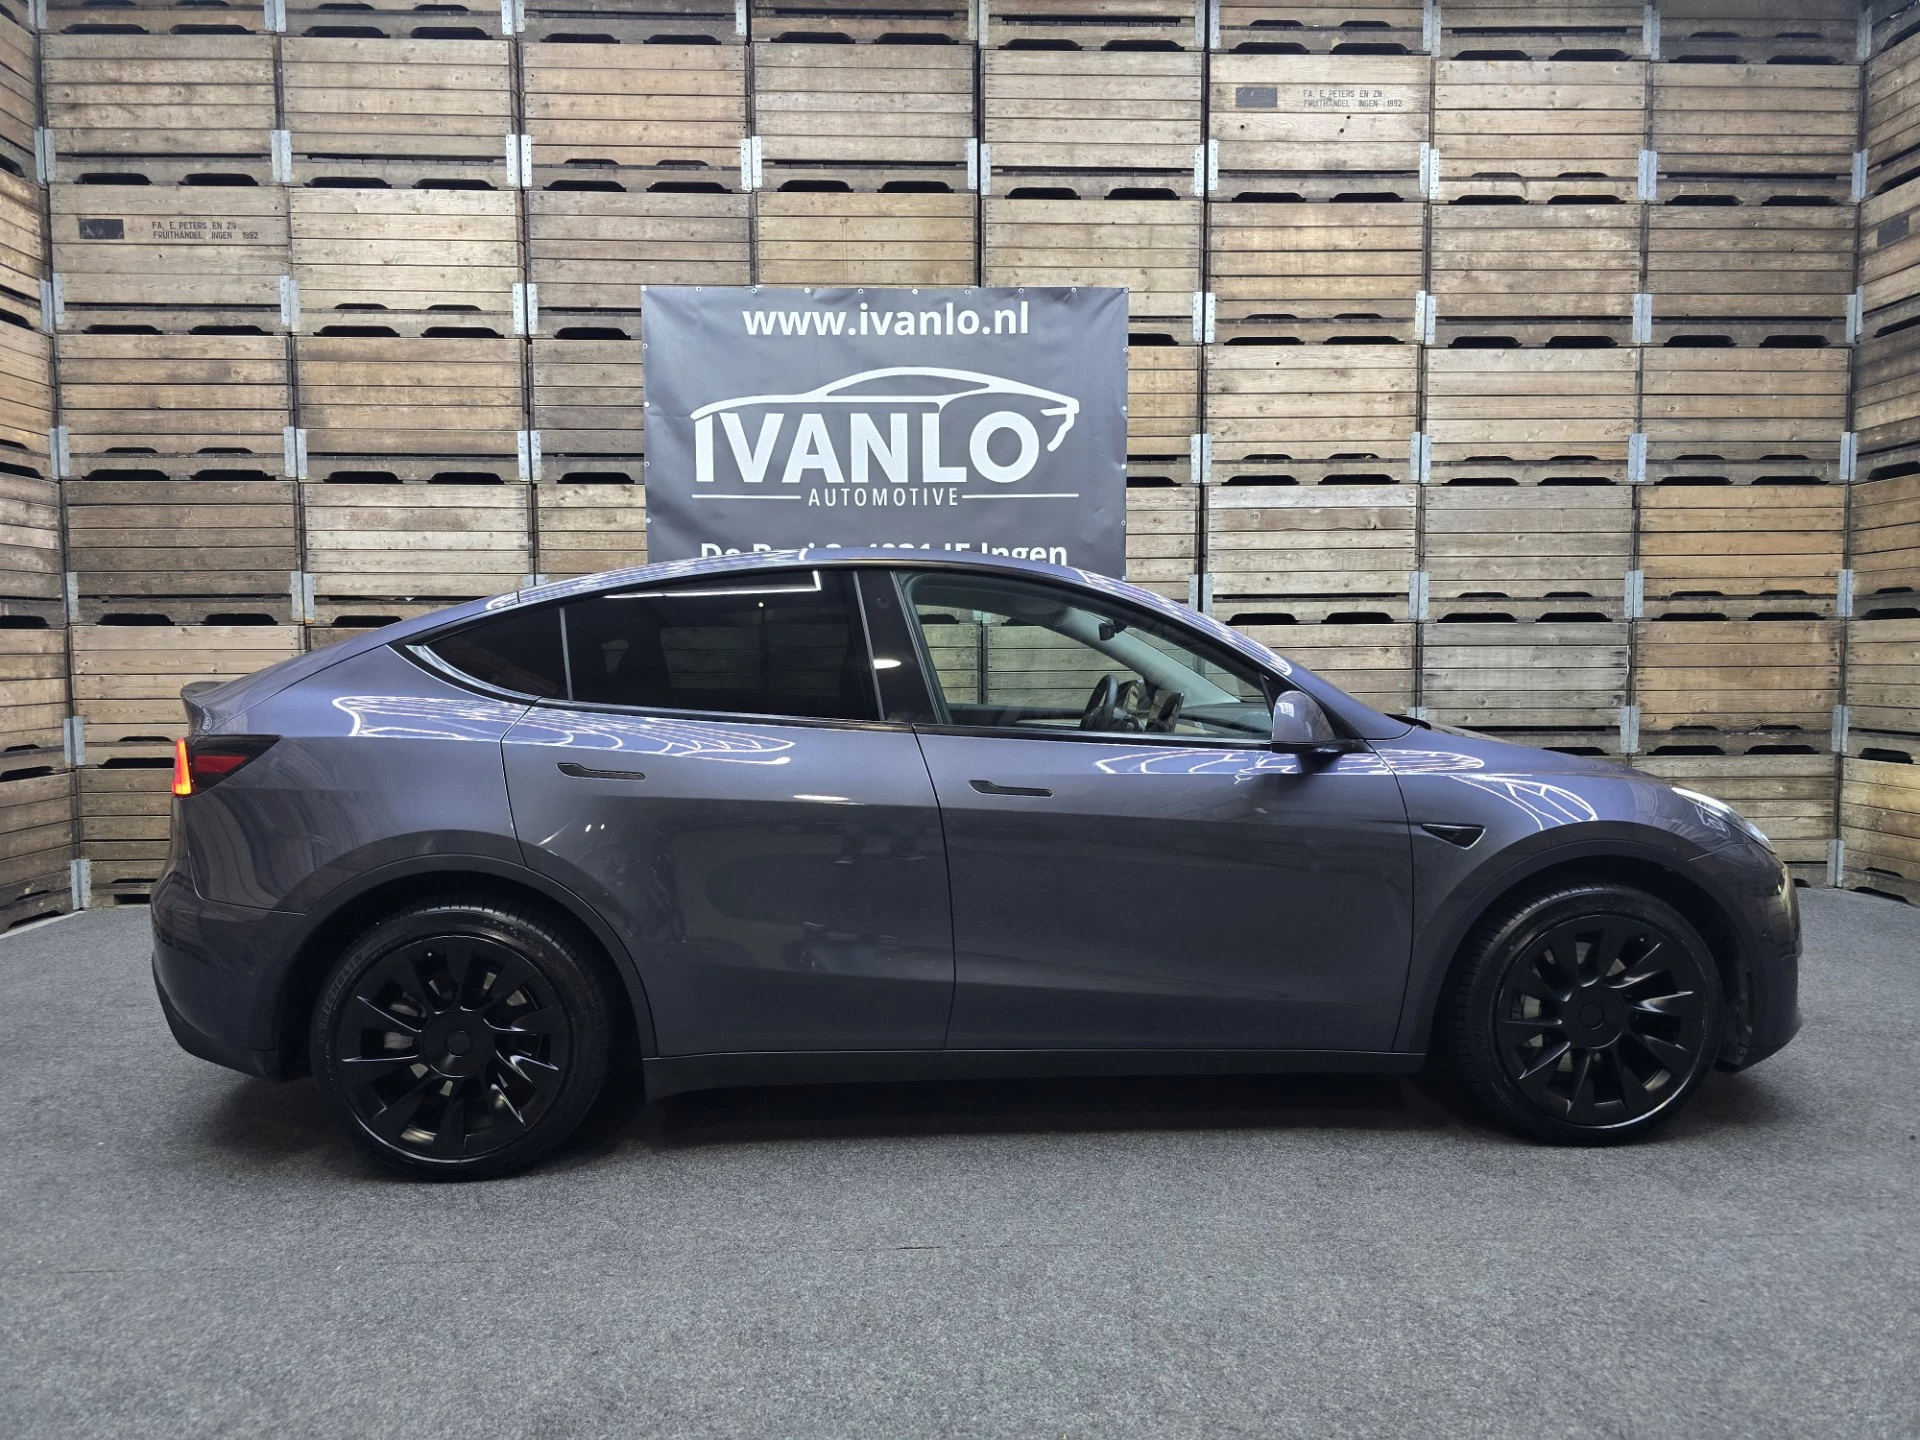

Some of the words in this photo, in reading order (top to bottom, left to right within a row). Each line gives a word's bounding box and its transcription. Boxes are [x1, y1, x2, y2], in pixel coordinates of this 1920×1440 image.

[1328, 89, 1355, 98] PETERS
[1359, 89, 1369, 98] EN
[1303, 99, 1350, 108] FRUITHANDEL
[1358, 99, 1378, 108] INGEN
[178, 221, 208, 230] PETERS
[212, 221, 223, 230] EN
[153, 231, 202, 239] FRUITHANDEL
[211, 231, 232, 239] INGEN
[742, 301, 1029, 336] www.ivanlo.nl
[694, 411, 1040, 483] IVANLO
[807, 487, 959, 507] AUTOMOTIVE
[701, 542, 741, 558] D
